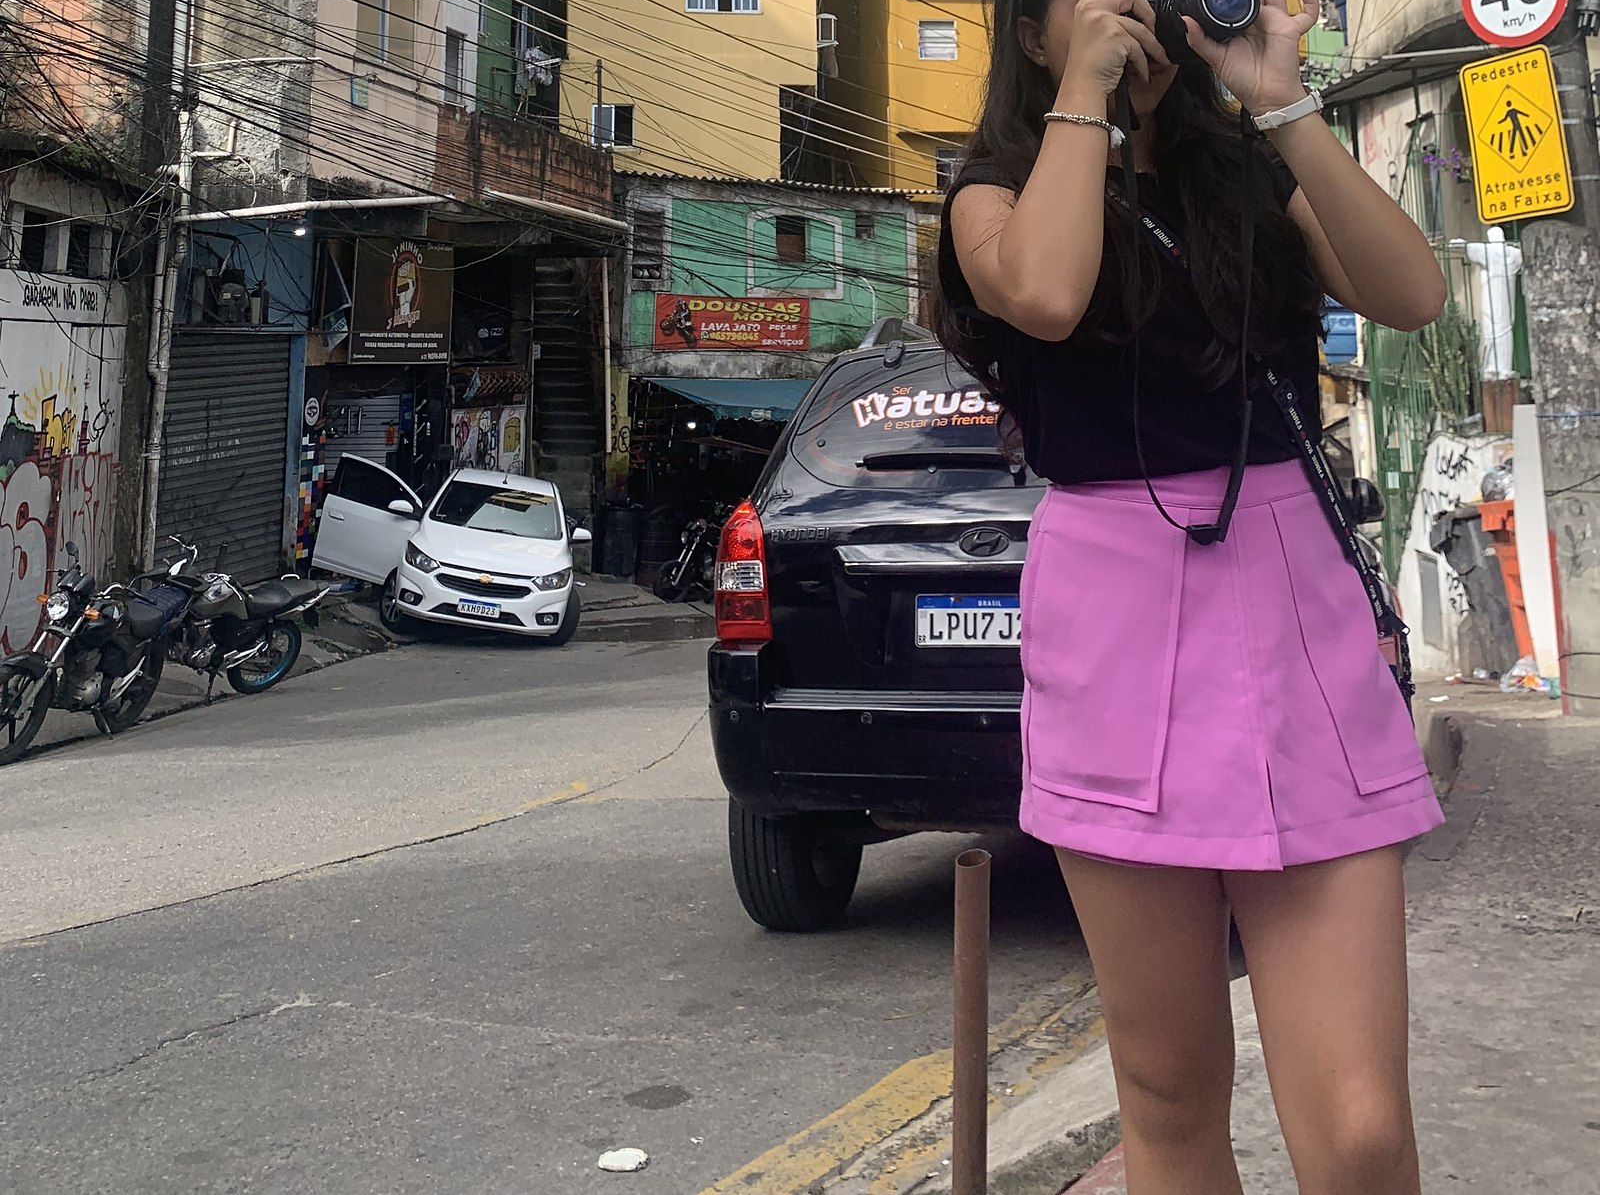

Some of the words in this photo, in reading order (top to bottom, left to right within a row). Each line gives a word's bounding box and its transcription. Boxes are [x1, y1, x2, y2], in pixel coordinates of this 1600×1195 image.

[1502, 11, 1537, 28] km/h
[1471, 57, 1539, 85] Pedestre
[1485, 170, 1561, 195] Atravesse
[1489, 198, 1507, 213] na
[1514, 190, 1562, 209] Faixa
[688, 299, 801, 313] DOUGLAS
[732, 312, 801, 322] MOTOS
[701, 322, 731, 331] LAVA
[732, 323, 761, 332] JATO
[768, 323, 797, 332] PEÇAS
[761, 338, 804, 346] SERVIÇOS
[891, 386, 913, 396] Ser
[884, 420, 893, 431] é
[894, 418, 929, 430] estar
[931, 417, 948, 427] na
[951, 413, 999, 426] frente!
[460, 603, 496, 616] KXH9D23
[977, 599, 1002, 607] BRASIL
